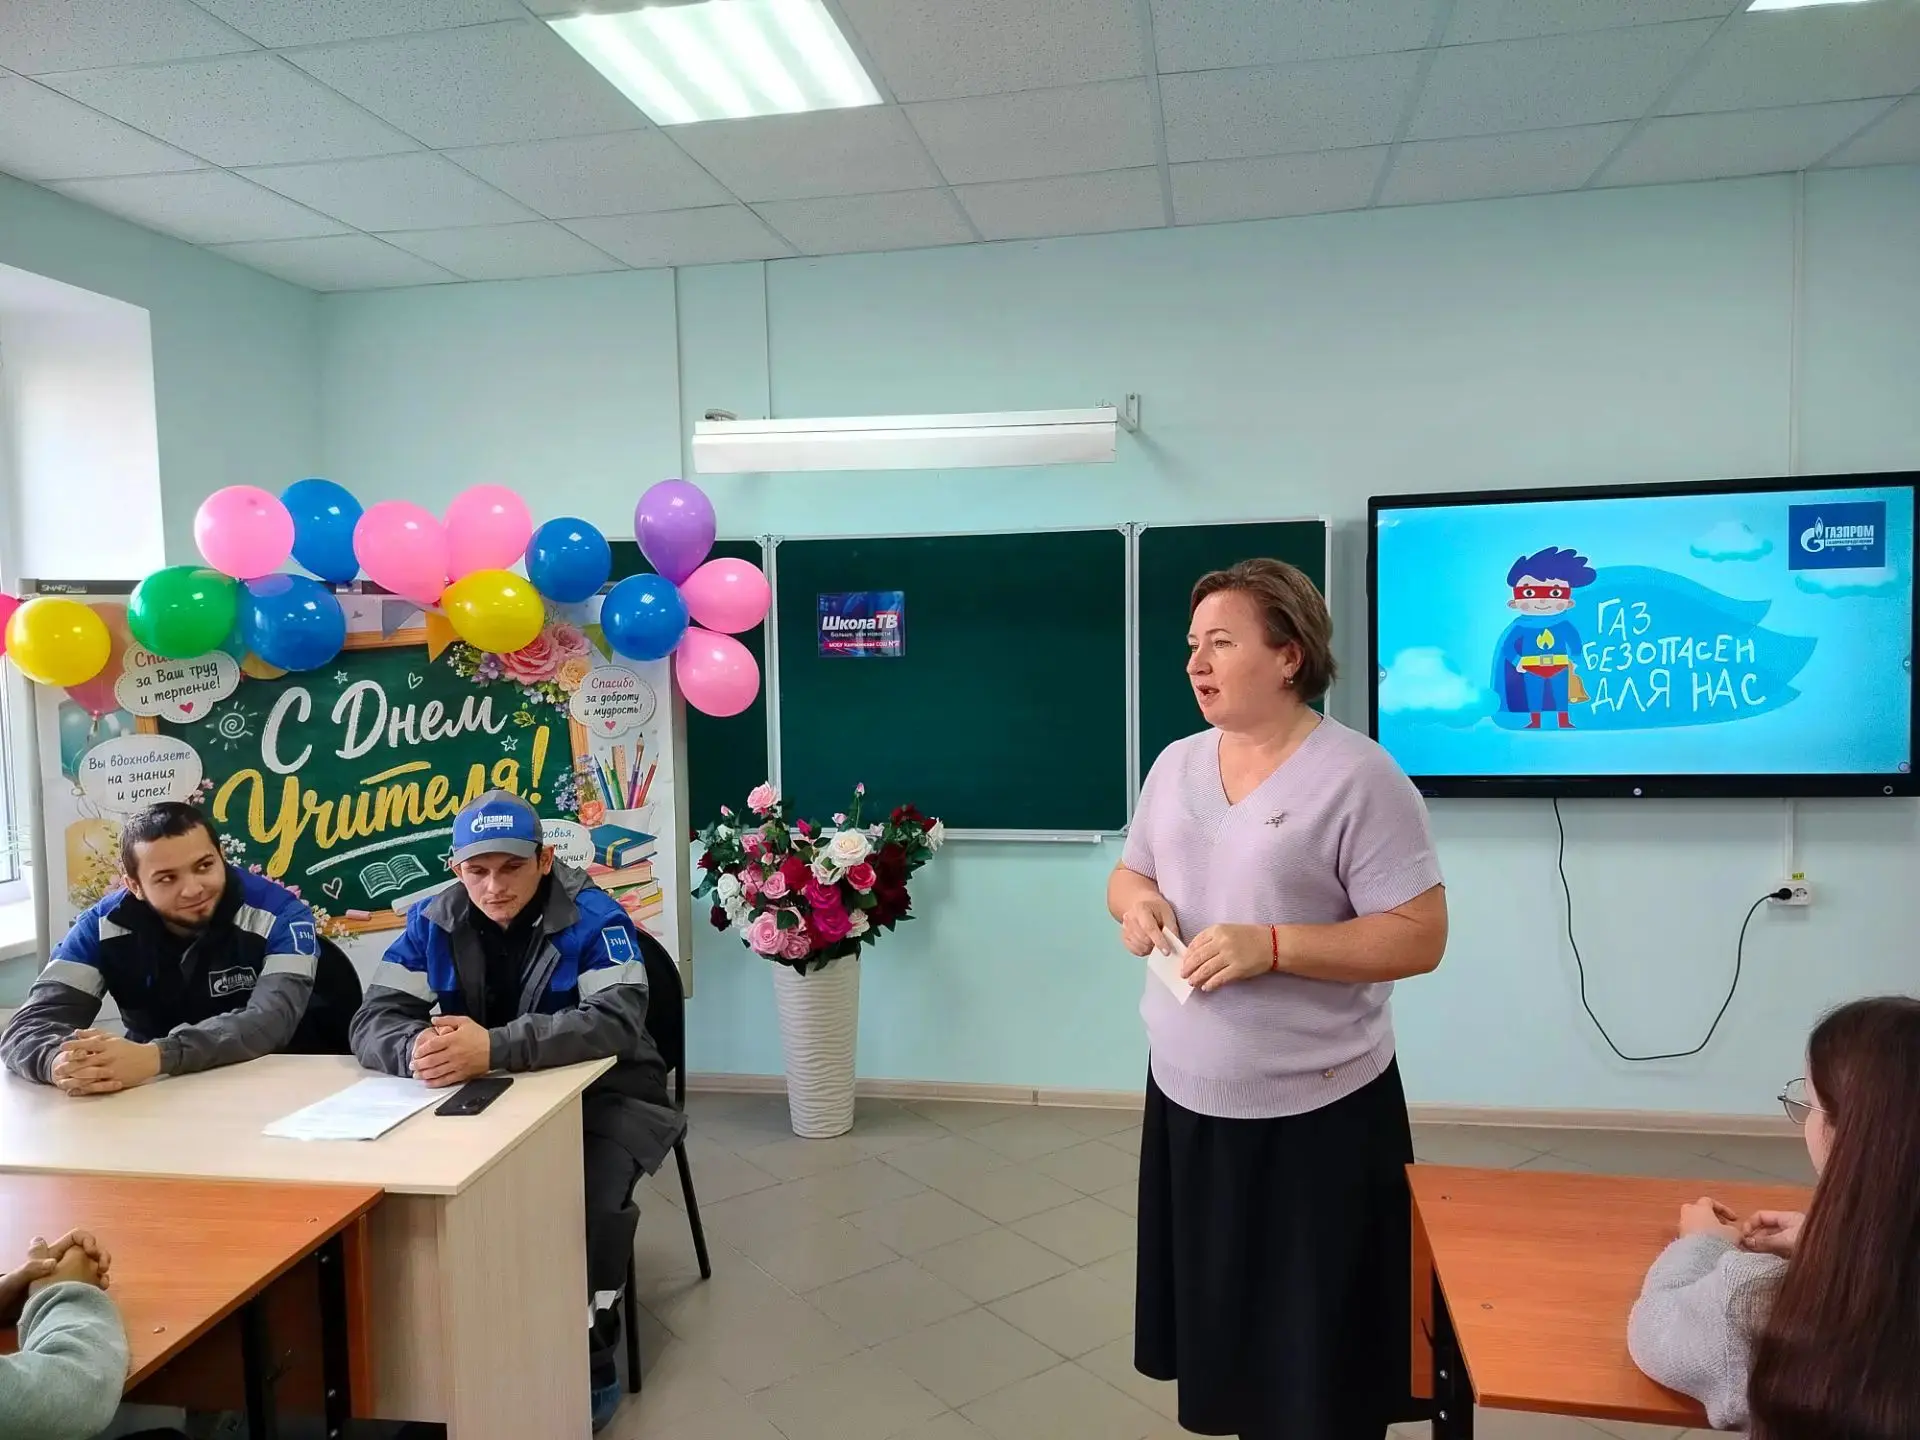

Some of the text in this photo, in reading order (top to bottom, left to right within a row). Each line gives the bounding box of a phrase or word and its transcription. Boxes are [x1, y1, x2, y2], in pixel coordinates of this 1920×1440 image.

[1825, 525, 1874, 538] ГАЗПРОМ
[822, 614, 898, 631] ШколаТВ
[1598, 598, 1651, 641] ГАЗ
[1582, 634, 1755, 672] БЕЗОПАСЕН
[136, 662, 218, 688] за Ваш труд
[591, 677, 634, 689] Спасибо
[140, 675, 220, 705] и терпение!
[586, 691, 640, 706] за доброту
[1590, 668, 1767, 715] ДЛЯ НАС
[593, 703, 642, 718] мудрость!
[261, 679, 508, 774] С Днем
[89, 751, 191, 769] Вы вдохновляете
[108, 768, 175, 785] на знания
[117, 782, 171, 803] и успех!
[484, 815, 513, 823] ГАЗПРОМ
